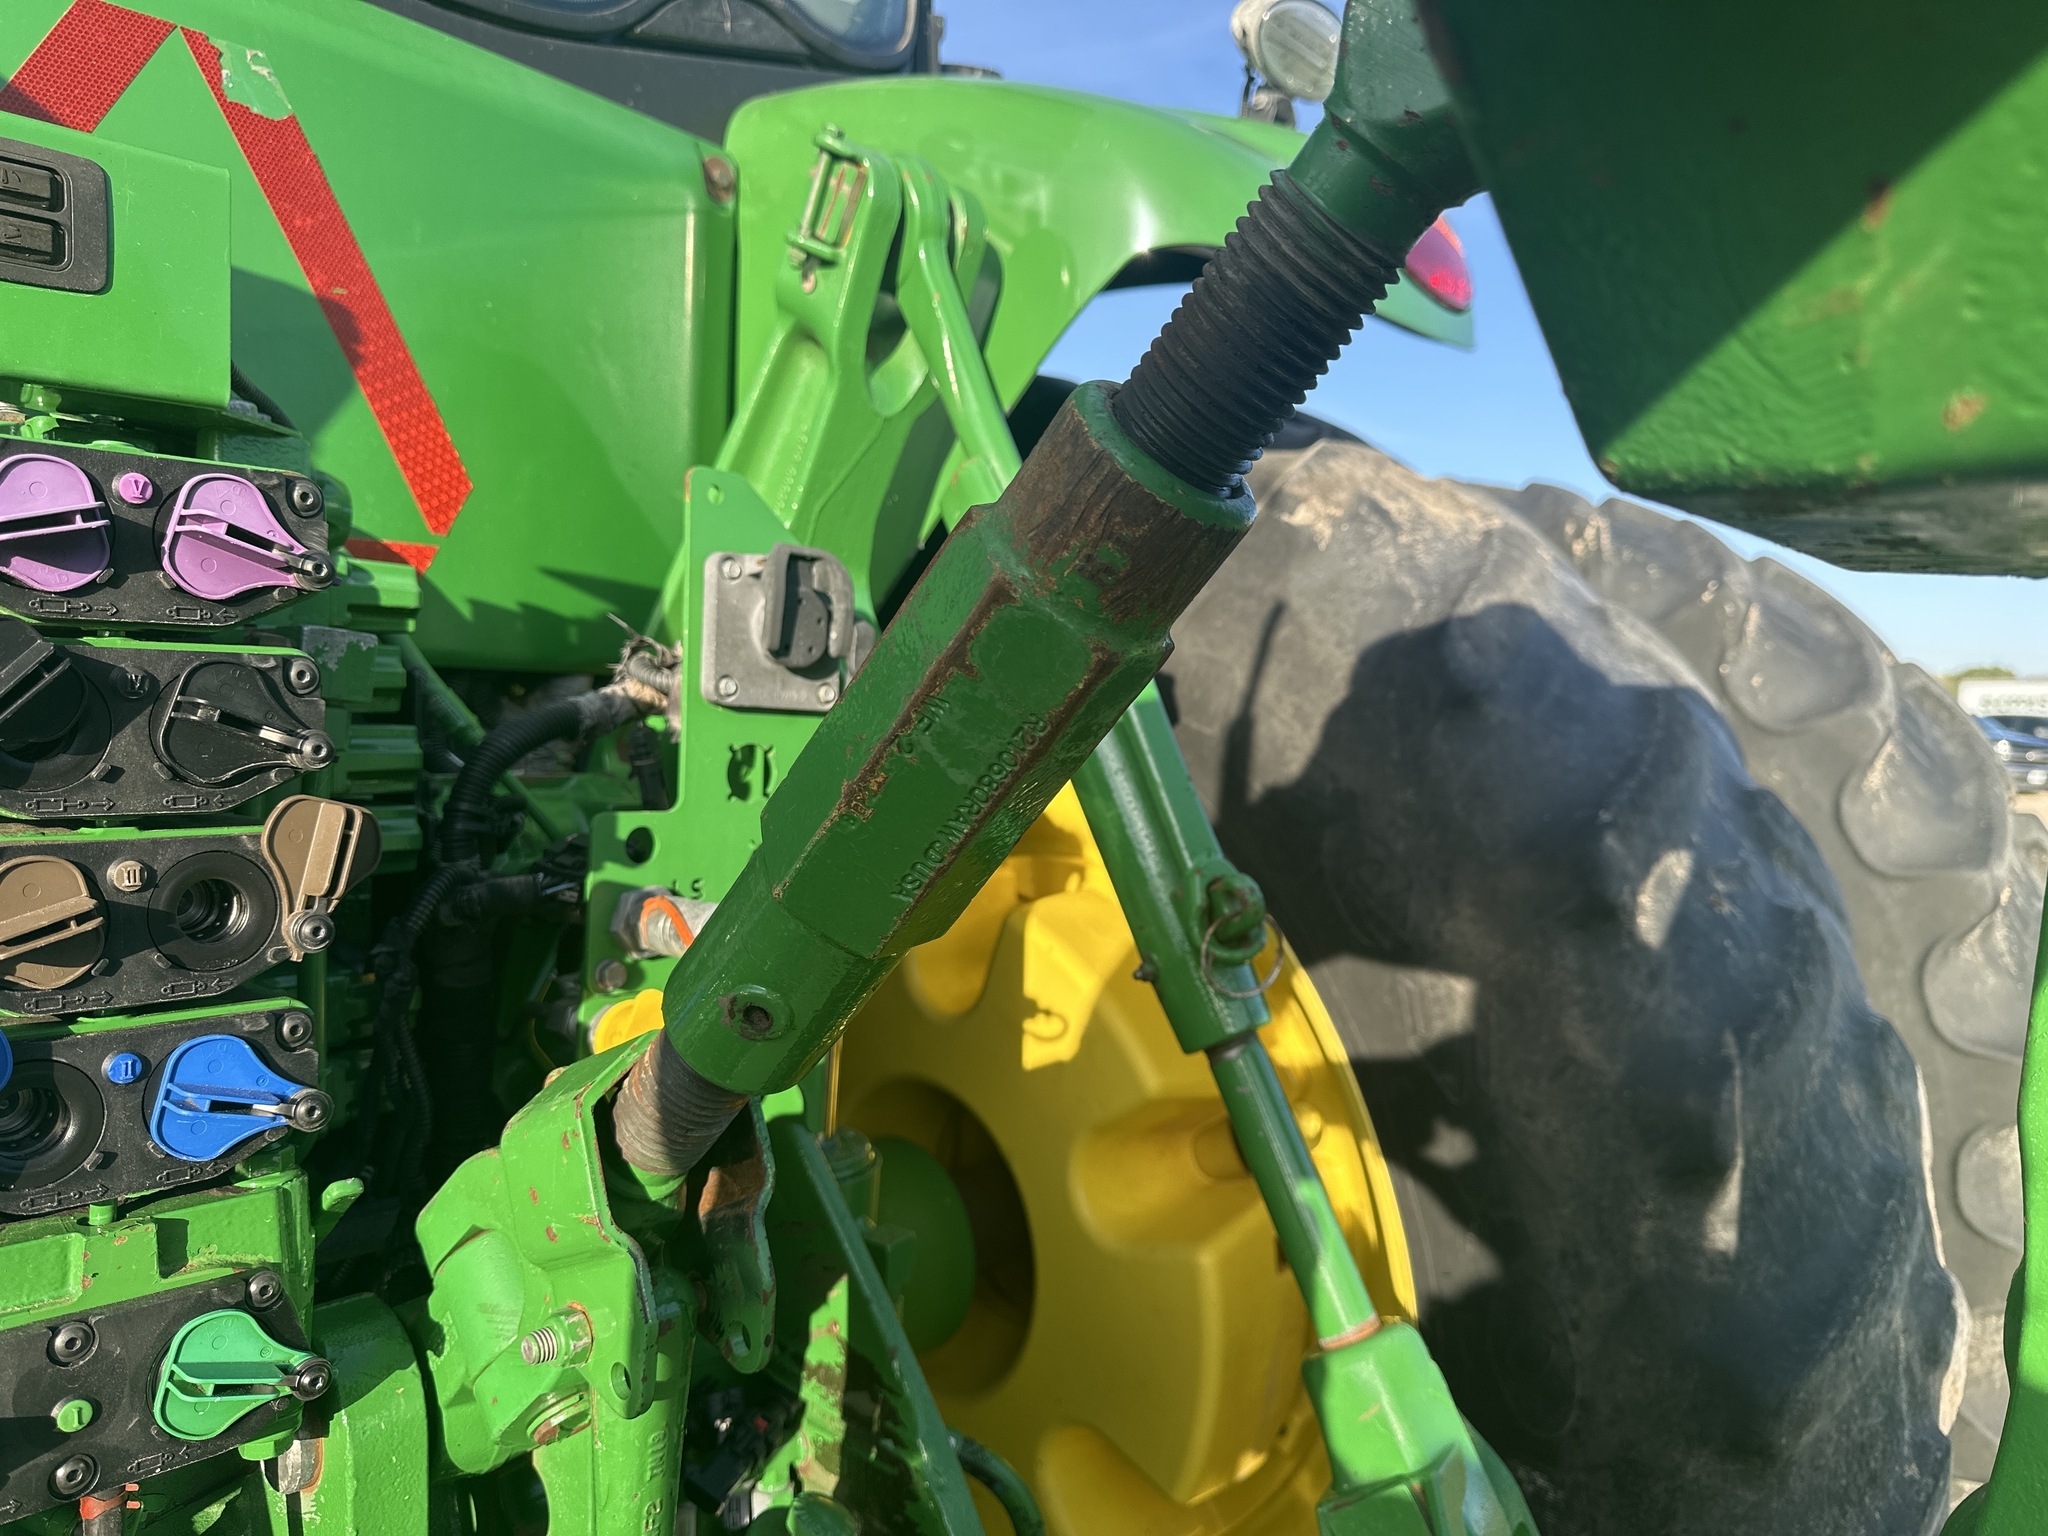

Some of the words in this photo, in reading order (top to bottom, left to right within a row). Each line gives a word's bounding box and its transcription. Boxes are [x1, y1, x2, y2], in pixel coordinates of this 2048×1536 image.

[128, 478, 147, 498] V
[121, 865, 143, 887] III
[120, 1059, 135, 1081] II
